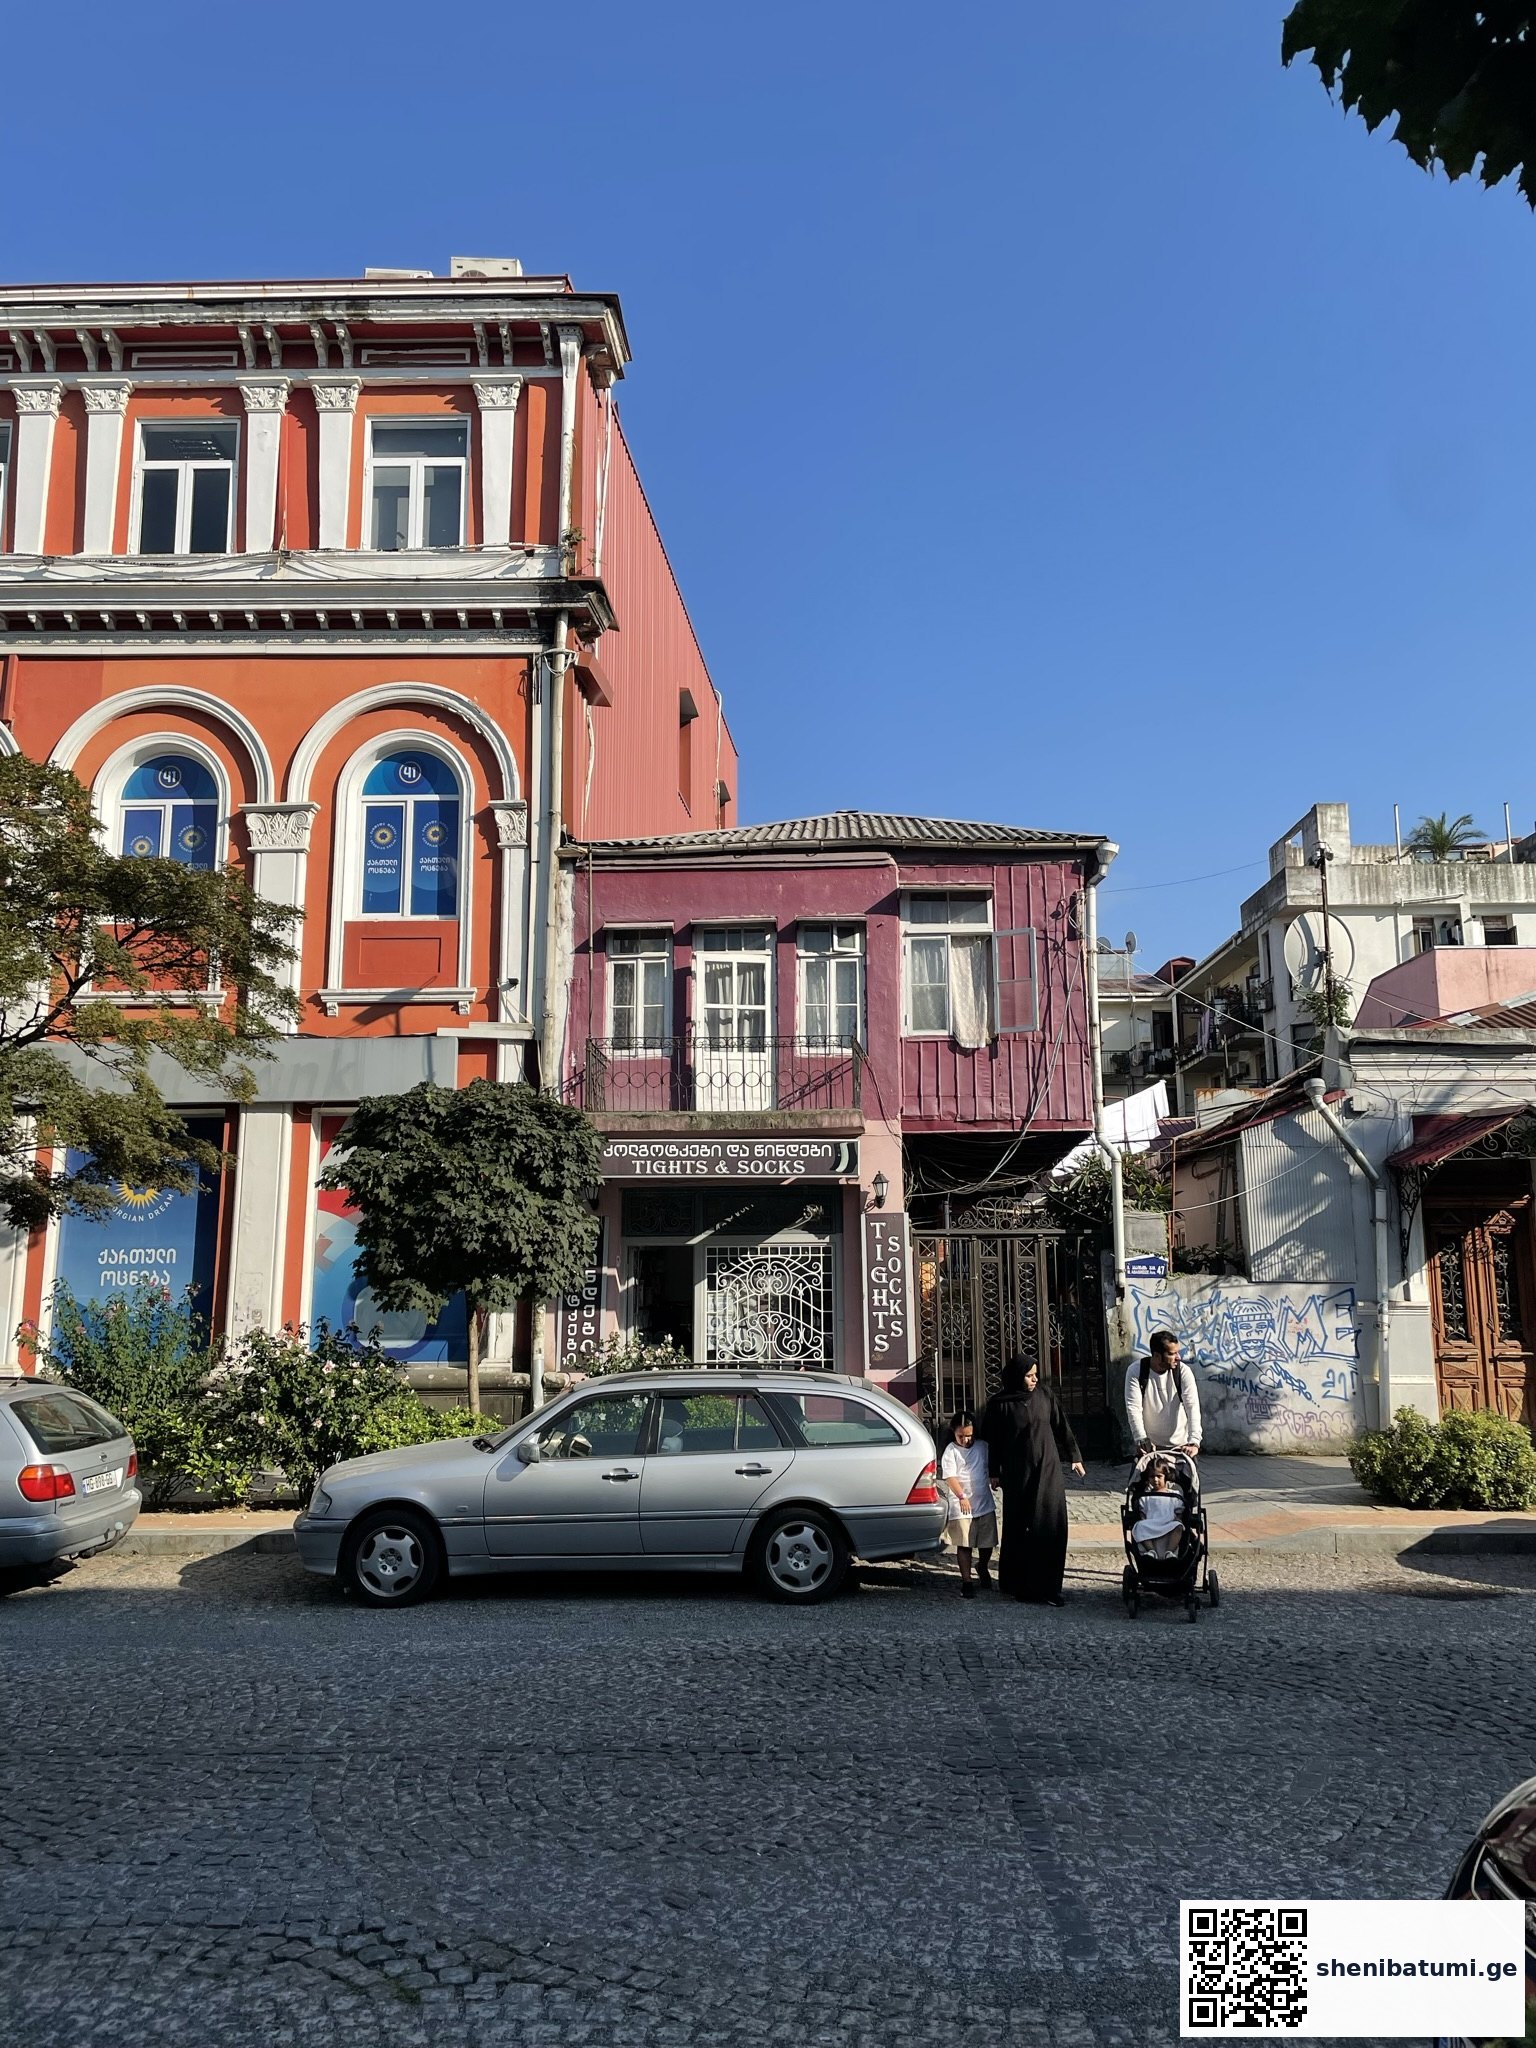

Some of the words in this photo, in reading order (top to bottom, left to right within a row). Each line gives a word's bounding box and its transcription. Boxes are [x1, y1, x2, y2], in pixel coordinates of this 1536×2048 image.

[162, 770, 177, 783] 41
[403, 766, 416, 779] 41
[366, 859, 398, 867] ქართული
[367, 867, 396, 875] ოცნება
[603, 1144, 722, 1157] კოლგოტკები
[726, 1144, 750, 1157] და
[754, 1144, 832, 1157] წინდები
[631, 1160, 708, 1174] TIGHTS
[714, 1159, 730, 1174] &
[737, 1160, 806, 1174] SOCKS
[111, 1205, 144, 1222] ORGIAN
[148, 1193, 175, 1220] DREAM
[97, 1248, 177, 1265] ქართული
[1156, 1265, 1165, 1275] 47
[869, 1222, 890, 1353] TIGHTS
[887, 1236, 904, 1338] SOCKS
